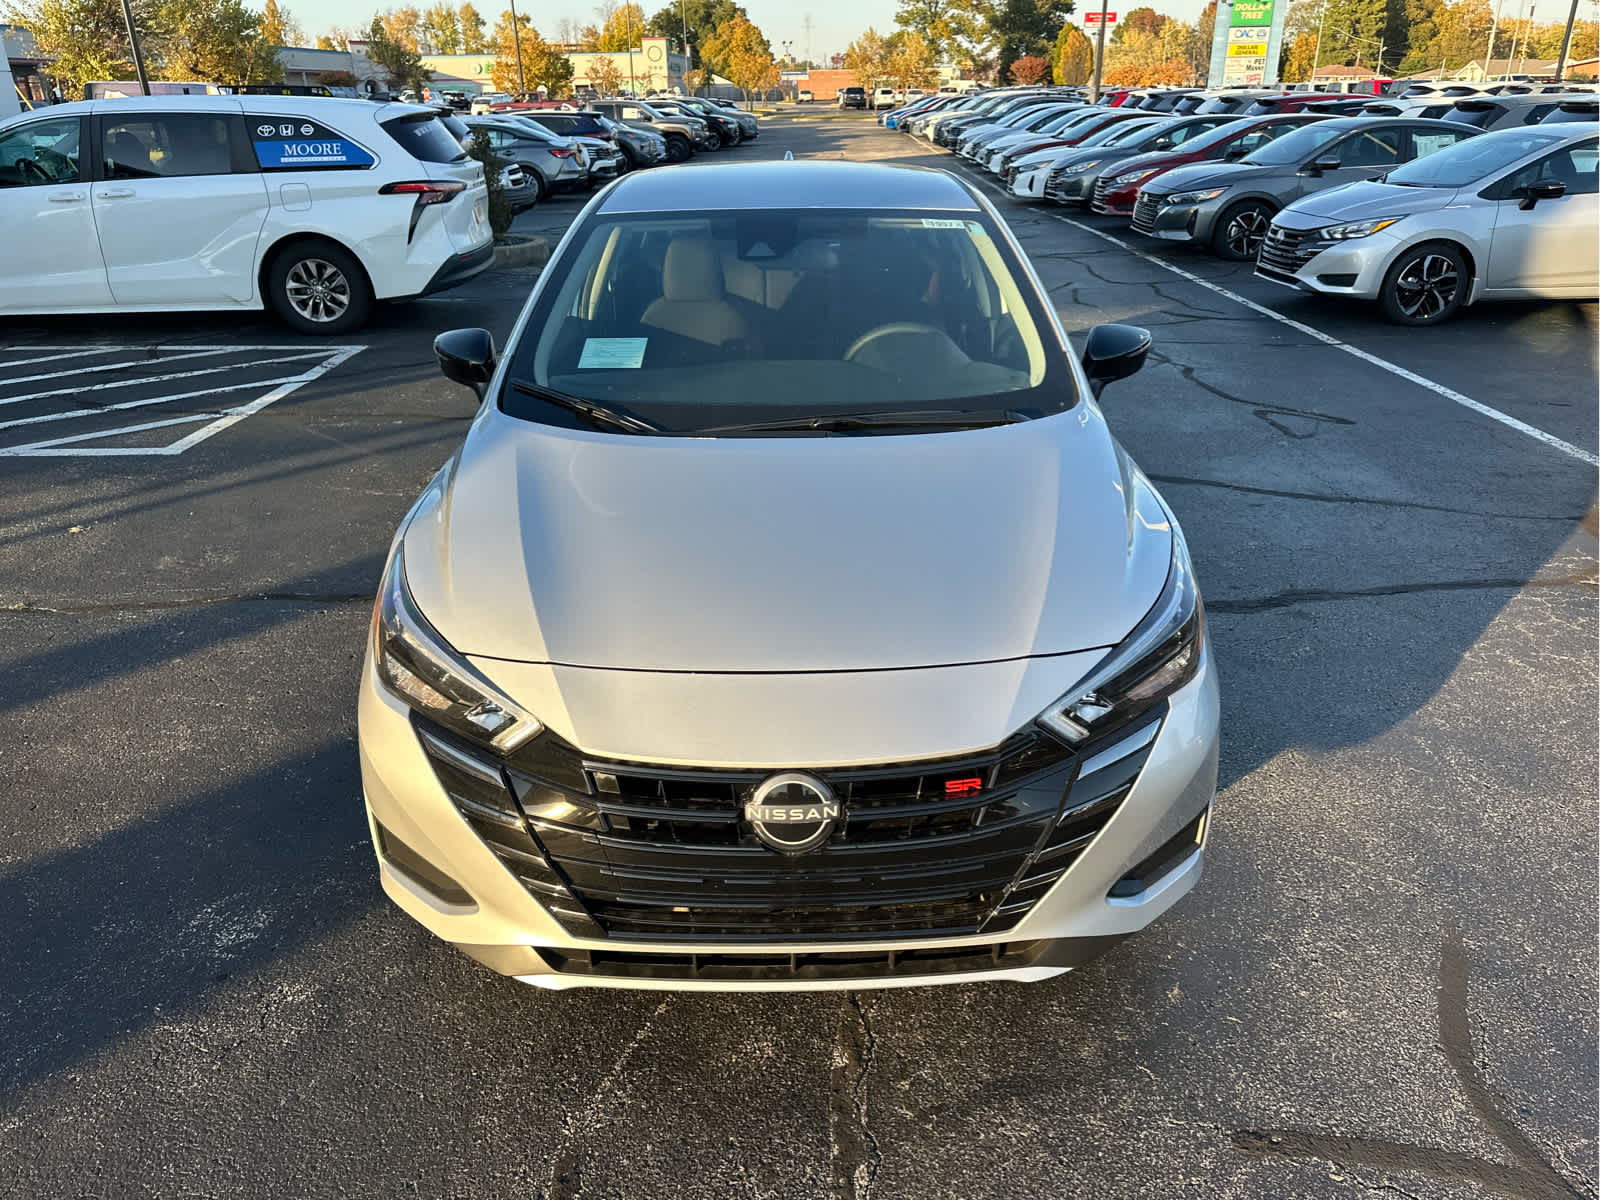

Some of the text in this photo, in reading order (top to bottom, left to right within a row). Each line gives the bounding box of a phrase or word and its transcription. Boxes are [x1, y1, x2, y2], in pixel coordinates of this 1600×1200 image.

[284, 143, 342, 156] MOORE
[945, 778, 982, 793] SR
[747, 805, 838, 821] NISSAN
